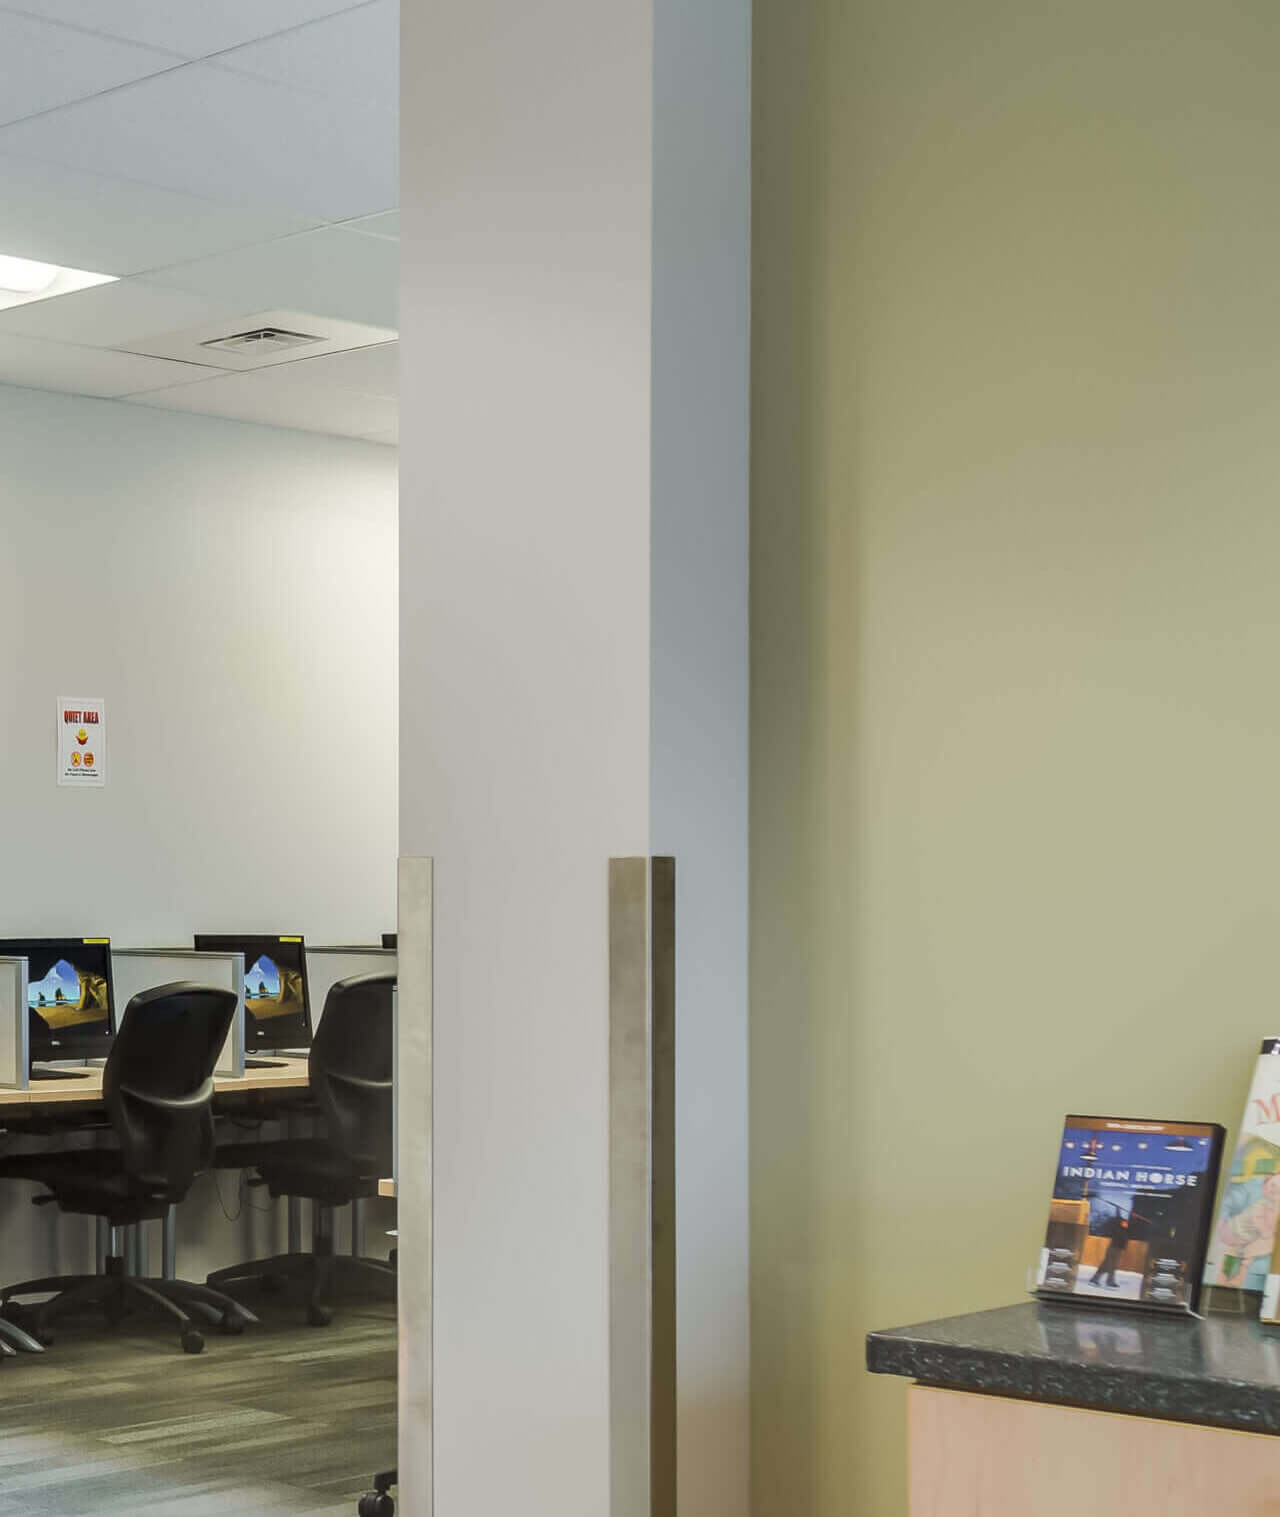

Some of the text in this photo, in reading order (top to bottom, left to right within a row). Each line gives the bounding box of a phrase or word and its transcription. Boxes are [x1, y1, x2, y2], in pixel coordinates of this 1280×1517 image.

[64, 710, 99, 725] QUIET AREA
[1062, 1165, 1130, 1182] INDIAN
[1135, 1172, 1198, 1187] HORSE
